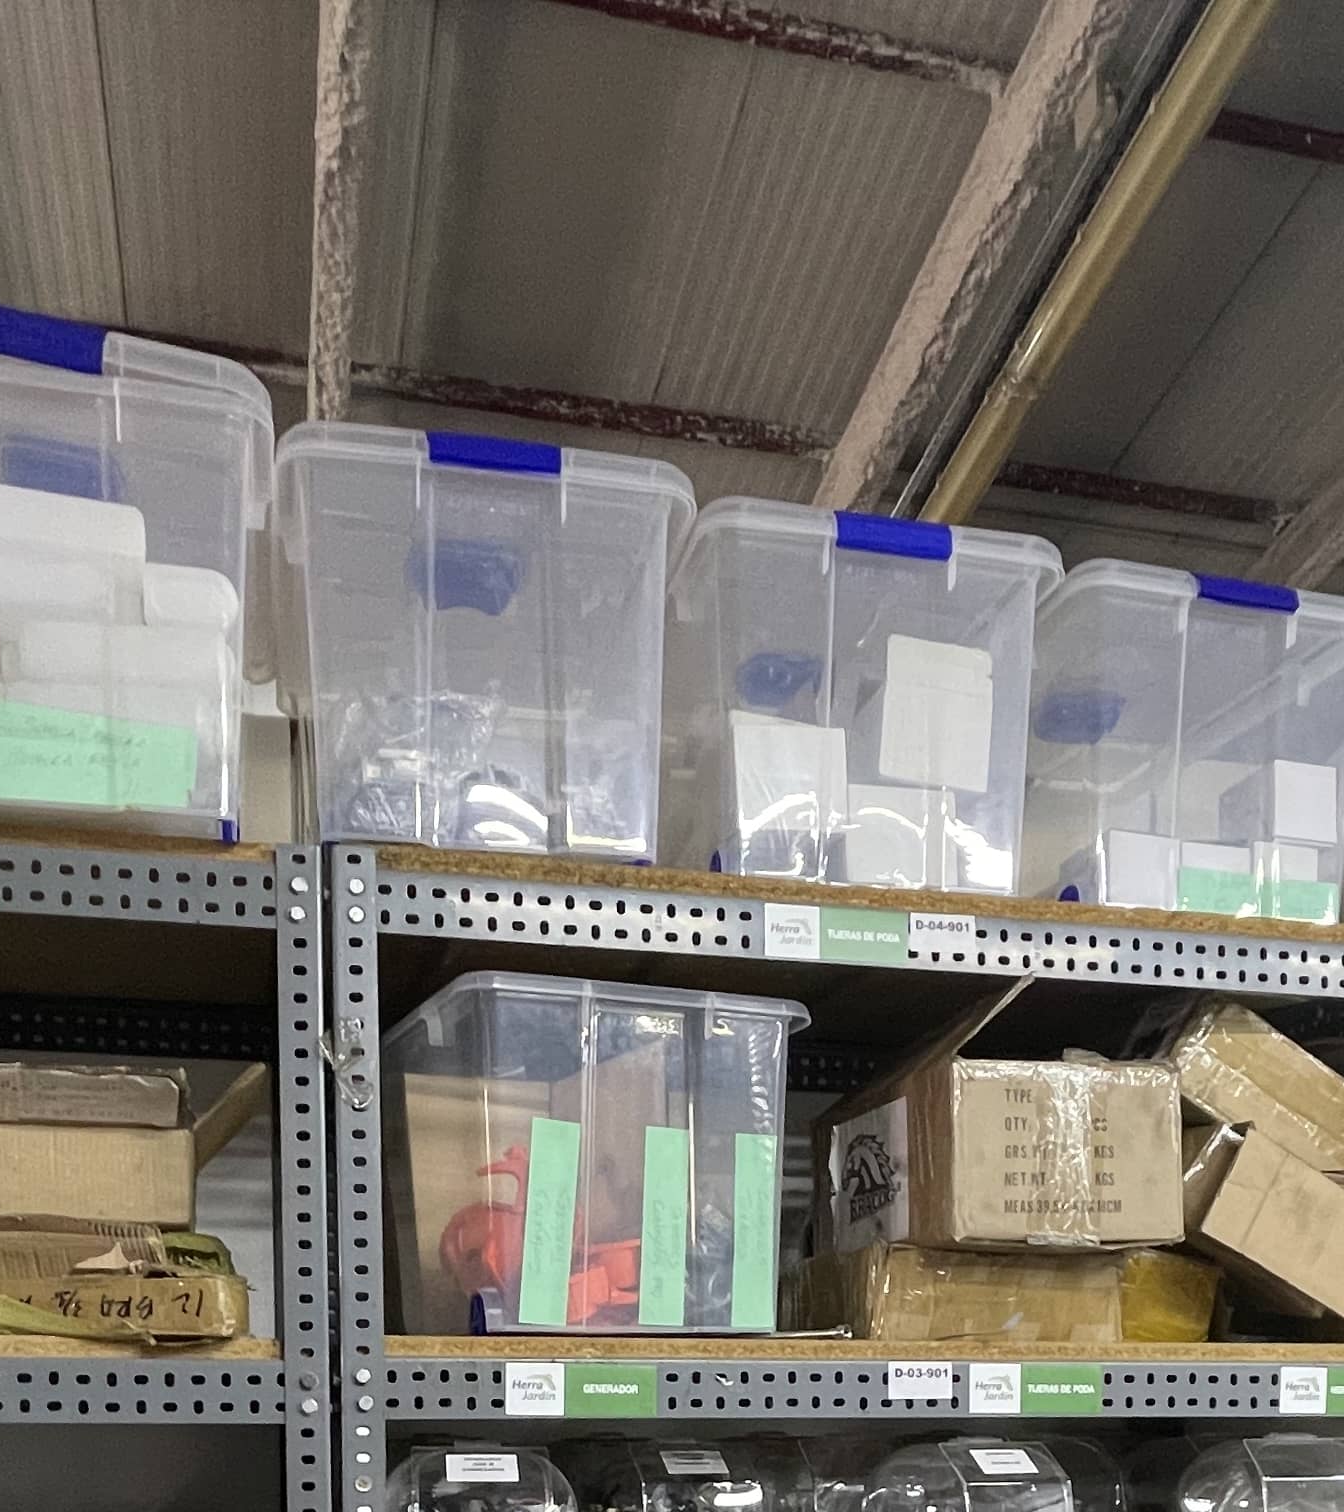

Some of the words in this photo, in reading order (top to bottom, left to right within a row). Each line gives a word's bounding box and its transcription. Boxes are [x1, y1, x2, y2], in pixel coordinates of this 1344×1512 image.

[915, 919, 970, 933] D-04-901
[827, 928, 862, 941] TIJERAS
[864, 931, 875, 942] DE
[876, 932, 900, 944] PODA
[1004, 1088, 1032, 1104] TYPE
[1005, 1145, 1027, 1159] GRS
[1004, 1172, 1027, 1186] NET
[1004, 1200, 1034, 1214] MEAS
[894, 1367, 949, 1379] D-03-901
[582, 1383, 639, 1395] GENERADOR
[1027, 1383, 1059, 1394] TIJERAS
[1060, 1384, 1071, 1395] DE
[1073, 1384, 1095, 1395] PODA
